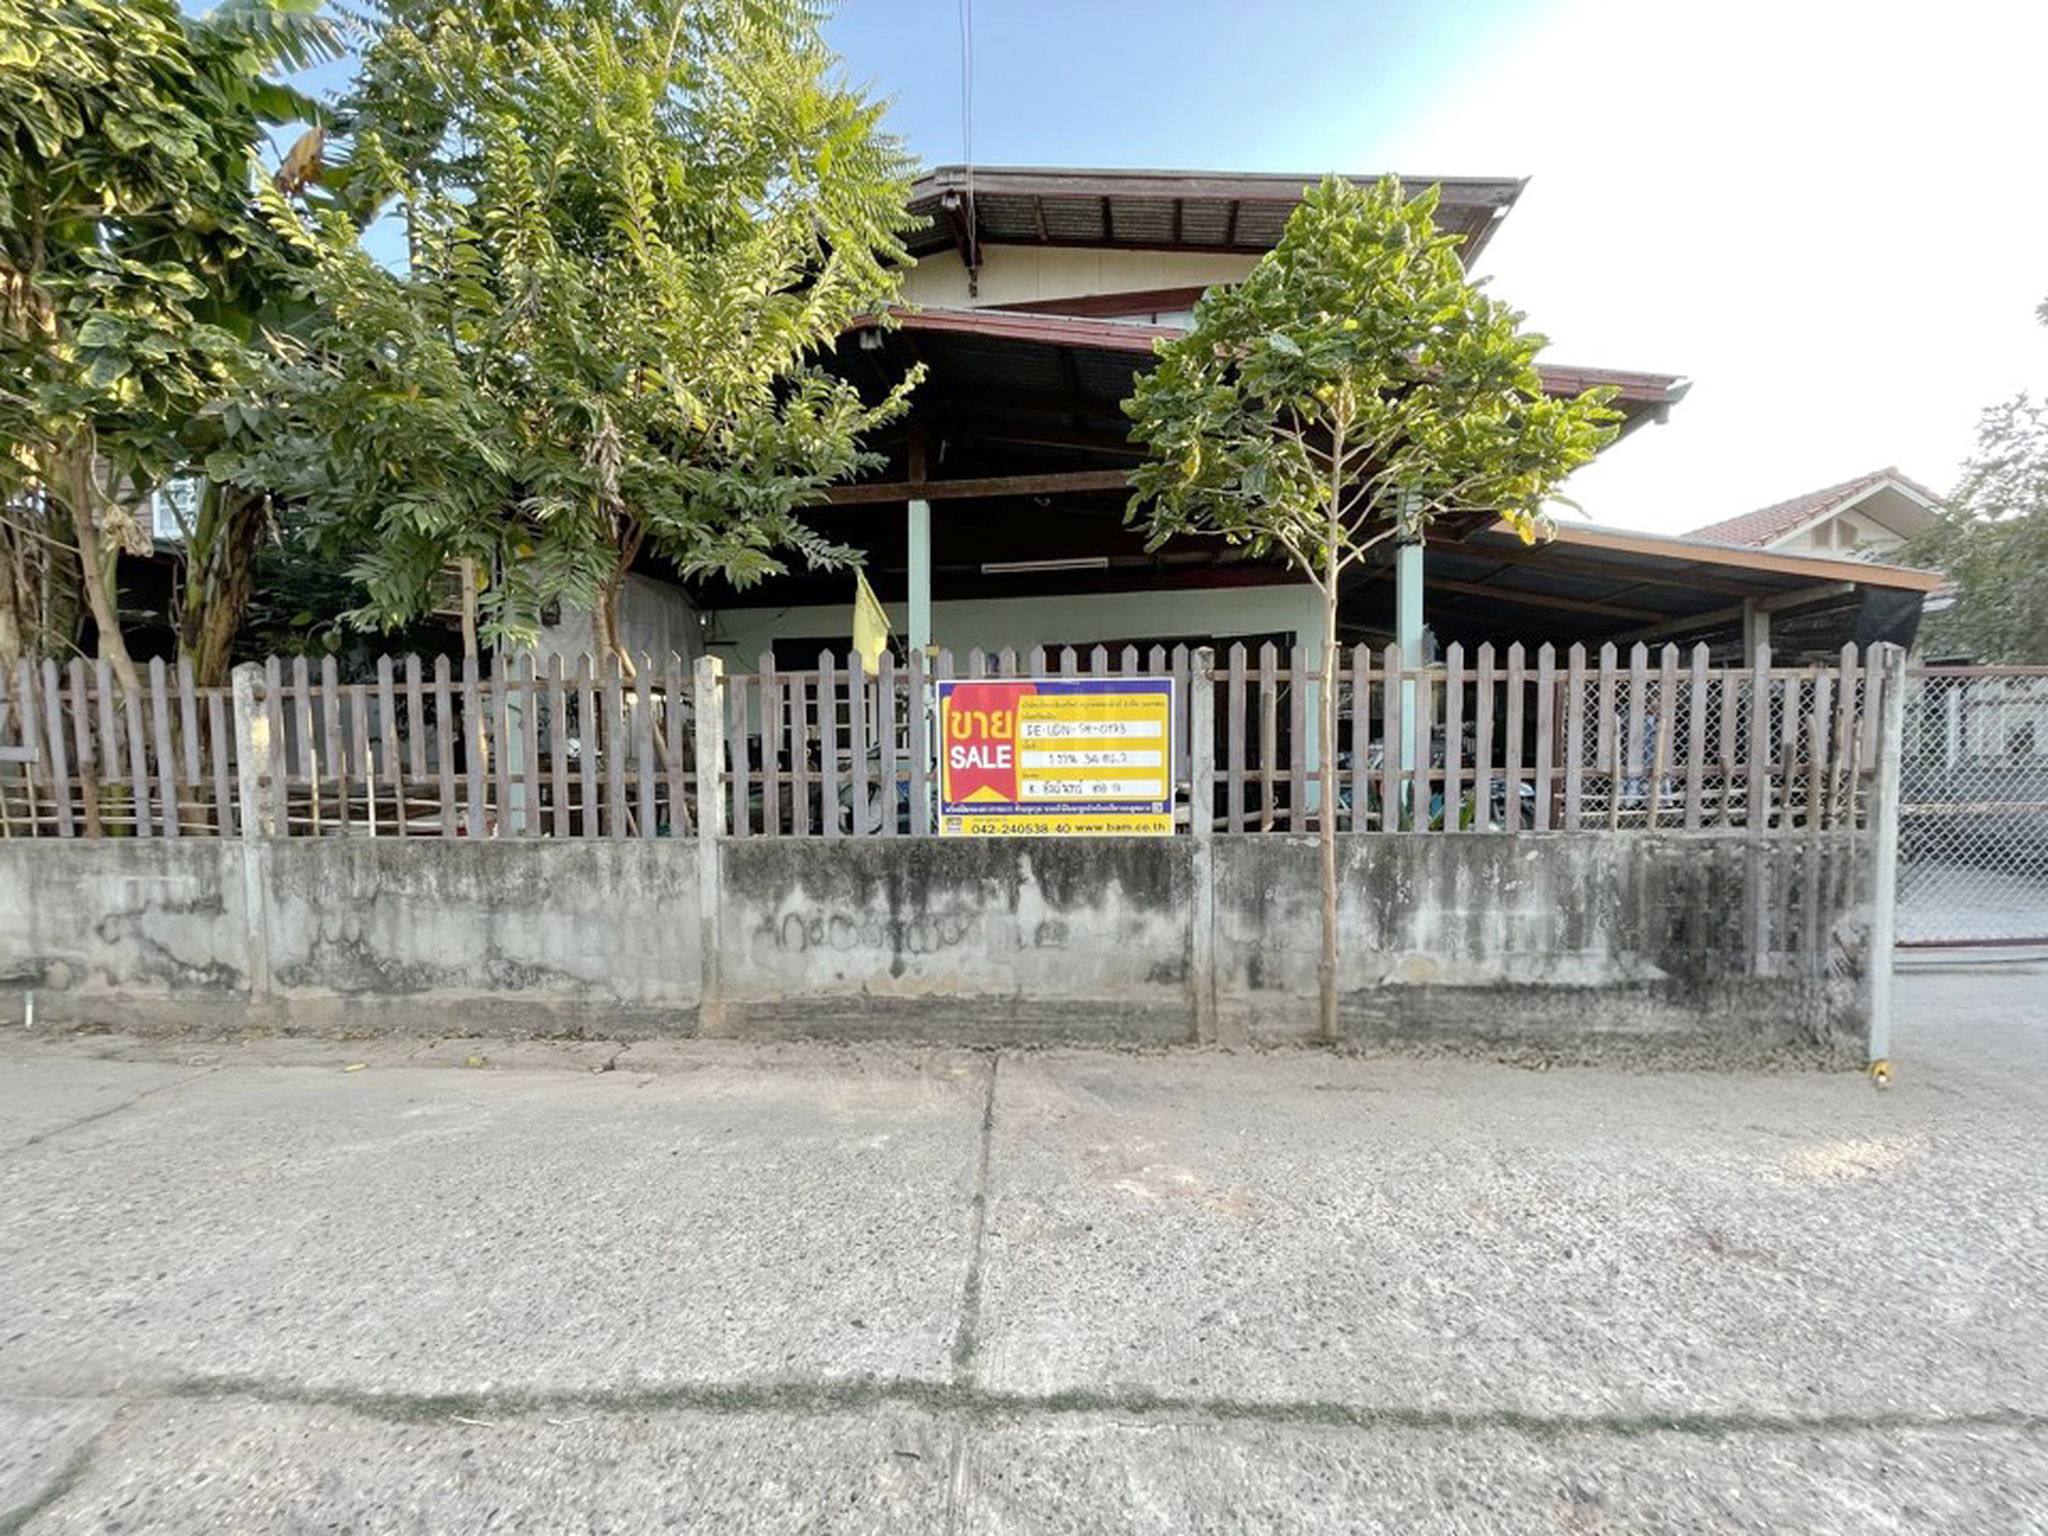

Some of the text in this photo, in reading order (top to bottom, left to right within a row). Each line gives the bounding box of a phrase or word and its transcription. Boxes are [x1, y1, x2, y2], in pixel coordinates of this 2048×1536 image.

[951, 710, 1013, 739] ขาย
[950, 745, 1012, 769] SALE
[1075, 821, 1166, 833] www.bam.co.th
